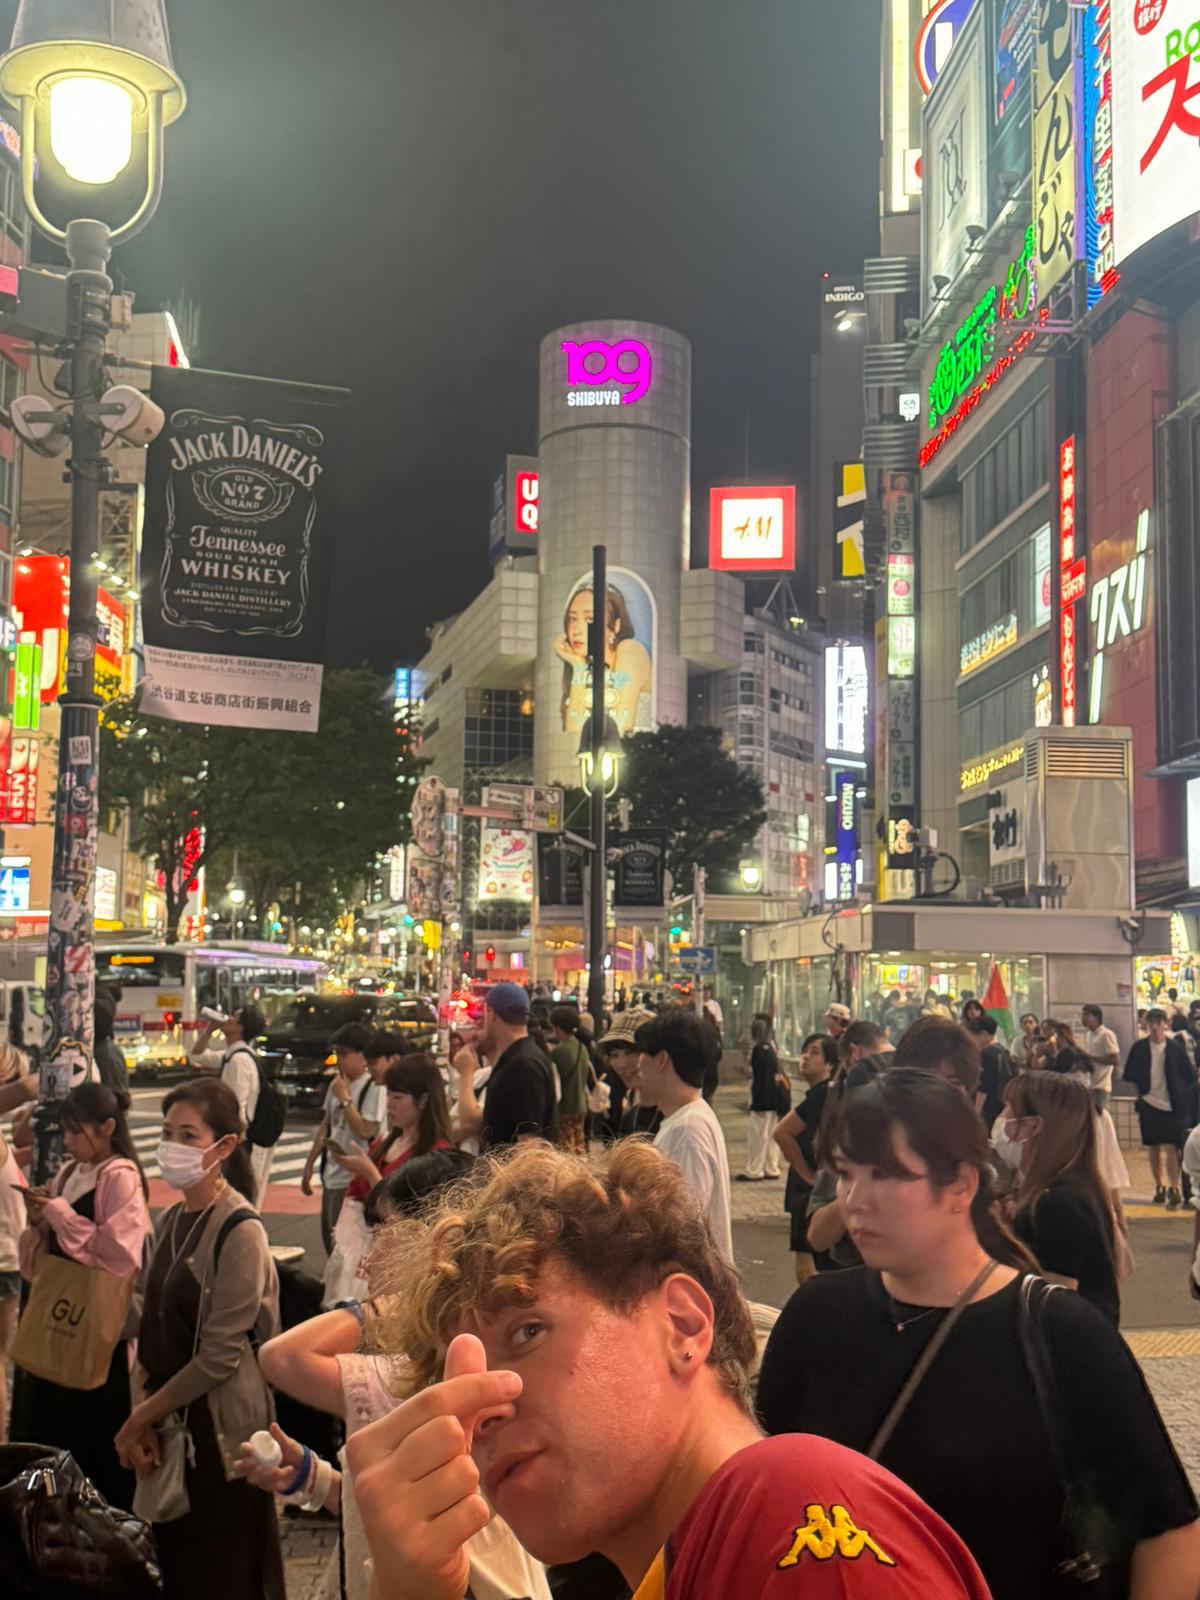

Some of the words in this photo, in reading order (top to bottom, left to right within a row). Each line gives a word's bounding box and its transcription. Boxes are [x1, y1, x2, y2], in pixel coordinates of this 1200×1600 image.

[825, 292, 864, 302] INDIGO
[561, 339, 652, 404] 109
[567, 390, 620, 407] SHIBUYA
[169, 432, 229, 471] JACK
[231, 425, 323, 488] DANIEL'S
[234, 474, 254, 483] OLD
[253, 485, 267, 500] 7
[224, 498, 260, 509] BRAND
[189, 525, 286, 557] Tennessee
[220, 526, 258, 537] QUALITY
[196, 551, 232, 561] SOUR
[238, 555, 278, 567] MASH
[181, 558, 291, 586] WHISKEY
[174, 588, 200, 598] JACK
[201, 591, 237, 602] DANIEL
[239, 595, 293, 608] DISTILLERY
[150, 684, 313, 715] 渋谷道玄坂商店街振興組合
[842, 782, 854, 831] MIZUHO
[52, 1300, 86, 1326] GU
